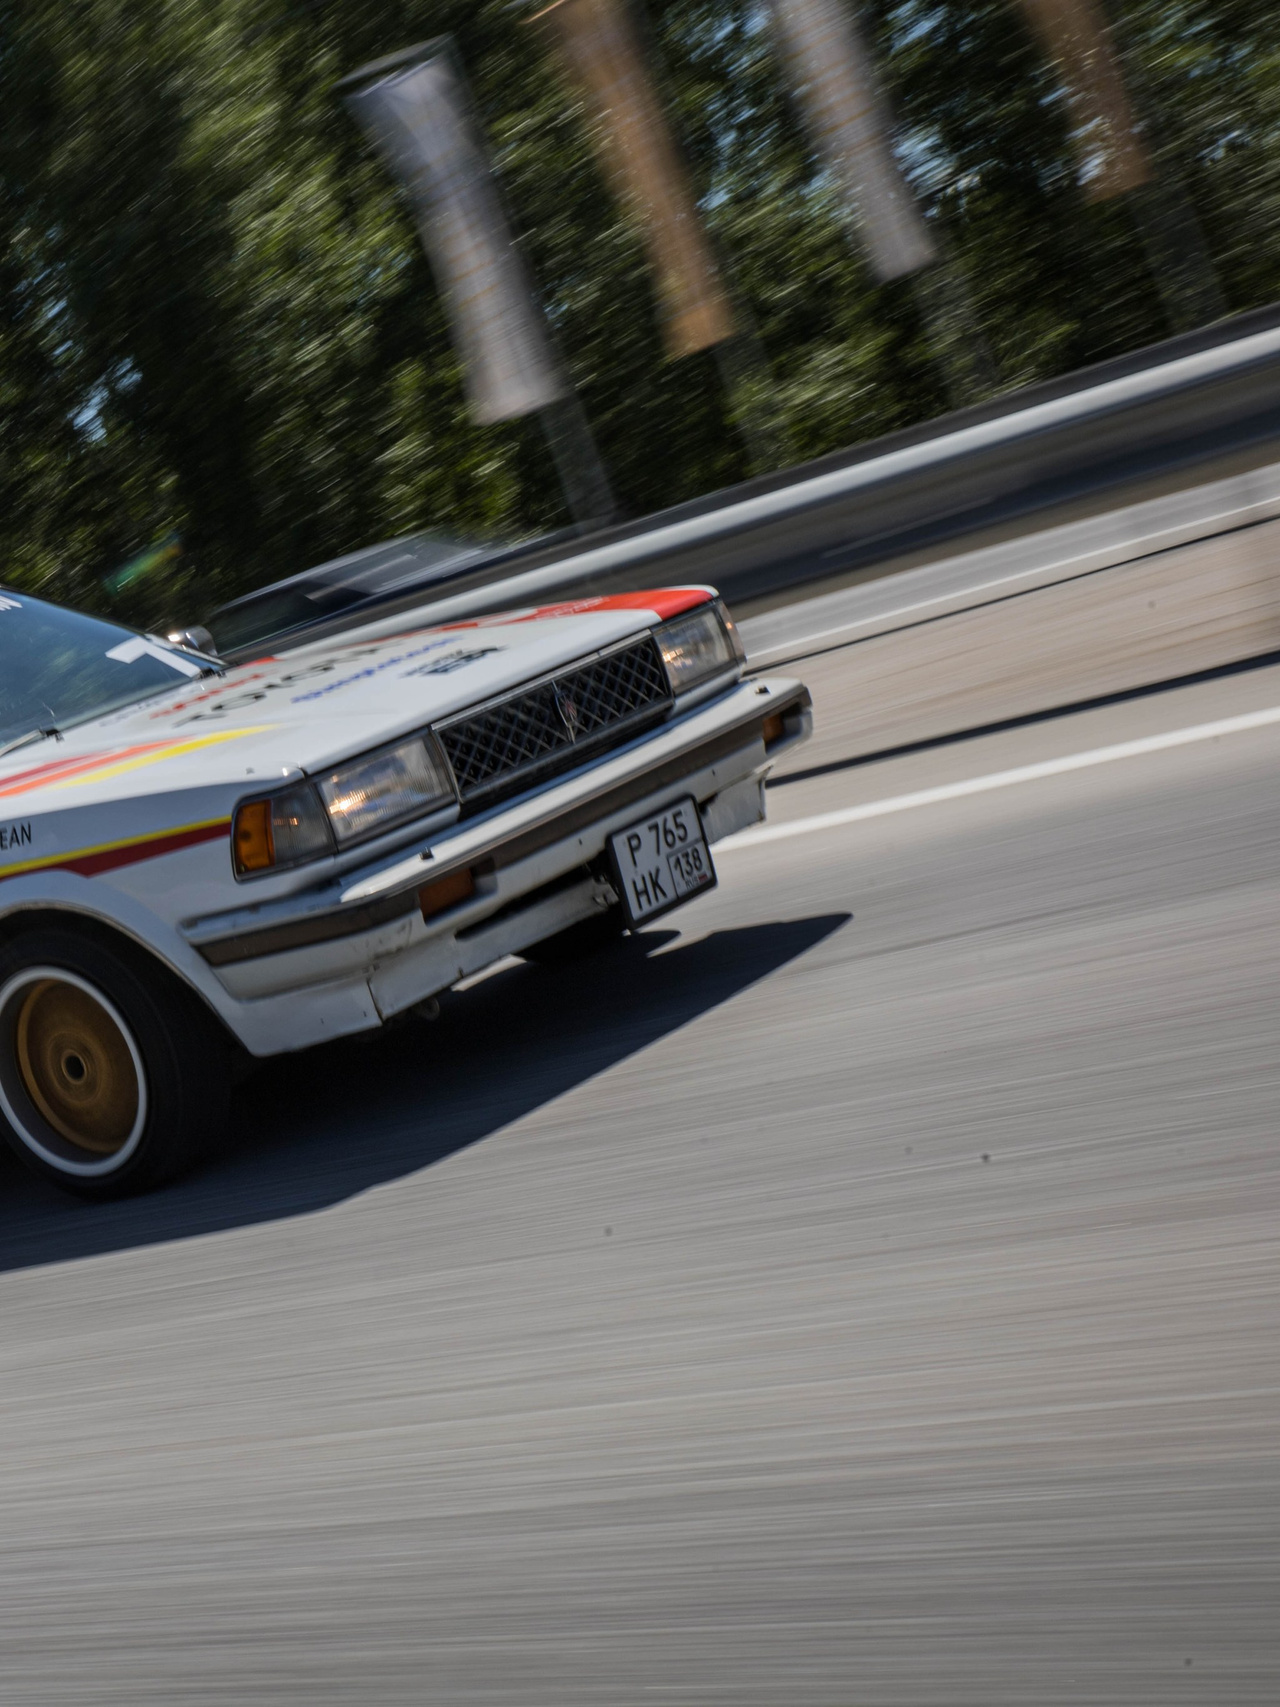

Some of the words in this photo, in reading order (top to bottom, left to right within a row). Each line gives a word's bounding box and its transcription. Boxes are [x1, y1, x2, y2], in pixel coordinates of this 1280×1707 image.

[626, 833, 642, 868] P
[647, 810, 688, 856] 765
[673, 846, 703, 880] 138
[631, 865, 668, 912] HK
